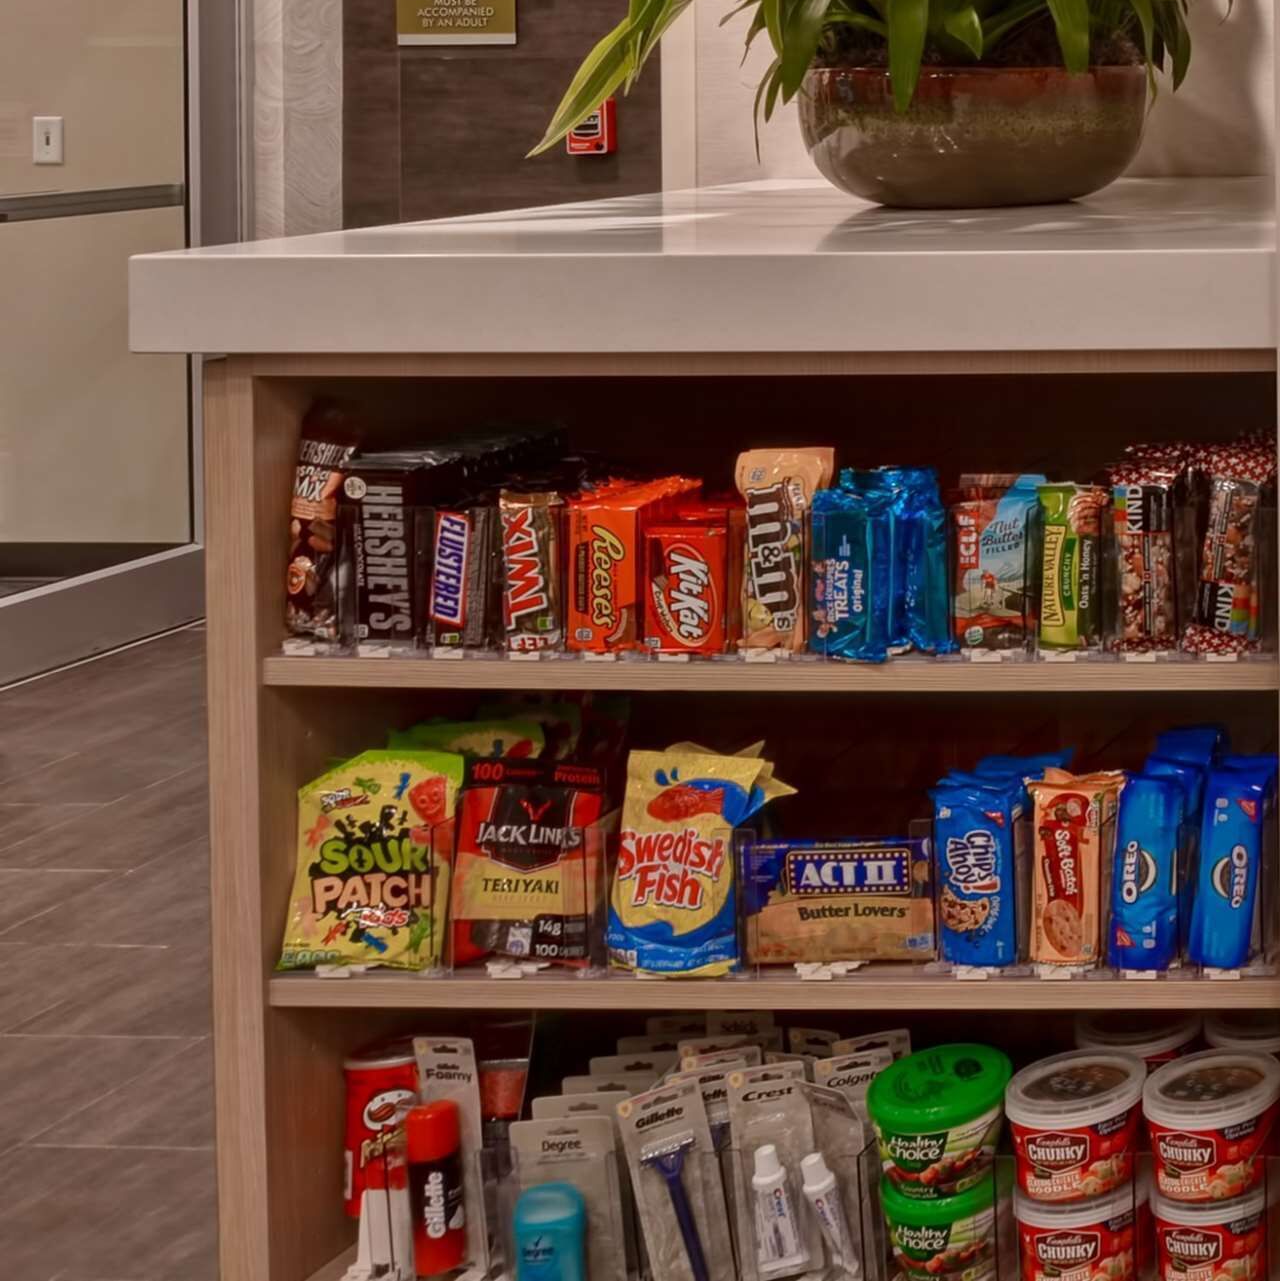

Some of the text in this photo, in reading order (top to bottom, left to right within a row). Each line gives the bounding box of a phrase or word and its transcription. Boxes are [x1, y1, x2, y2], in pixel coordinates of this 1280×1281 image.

[417, 7, 494, 17] ACCOMPANIED
[422, 17, 488, 28] BY AN ADULT
[1127, 485, 1142, 533] KIND
[959, 515, 978, 559] CLIF
[981, 530, 1024, 547] Butter
[990, 519, 1020, 536] Nut
[362, 485, 412, 631] HERSHEY'S
[985, 541, 1021, 555] FILLED
[1081, 539, 1093, 571] Honey
[432, 514, 466, 619] FLUSTERED
[502, 508, 547, 630] TWIX
[1043, 527, 1062, 622] NATURE VALLEY
[1063, 552, 1072, 597] CRUNCHY
[834, 560, 850, 620] TREATS
[1078, 586, 1089, 609] Oats
[1215, 583, 1235, 631] KIND
[476, 822, 521, 845] JACK
[320, 839, 429, 874] SOUR
[619, 829, 724, 882] Swedish
[965, 829, 993, 883] Chips
[1054, 829, 1078, 896] Soft Batch
[800, 860, 898, 887] ACT II
[1123, 840, 1138, 903] OREO
[1231, 844, 1249, 909] OREO
[313, 874, 431, 913] PATCH
[482, 878, 560, 895] TERIYAKI
[632, 865, 702, 909] Fish
[798, 904, 907, 920] Butter Lovers
[426, 1069, 472, 1084] Foamy
[742, 1085, 794, 1103] Crest
[635, 1107, 684, 1129] Gillette
[542, 1139, 583, 1153] Degree
[888, 1144, 941, 1161] Choice
[891, 1136, 945, 1149] Healthy
[1028, 1144, 1086, 1162] CHUNKY
[1159, 1141, 1213, 1163] CHUNKY
[425, 1173, 444, 1238] Gillette
[895, 1231, 945, 1251] Choice
[1038, 1241, 1097, 1260] CHUNKY
[1165, 1235, 1218, 1257] CHUNKY
